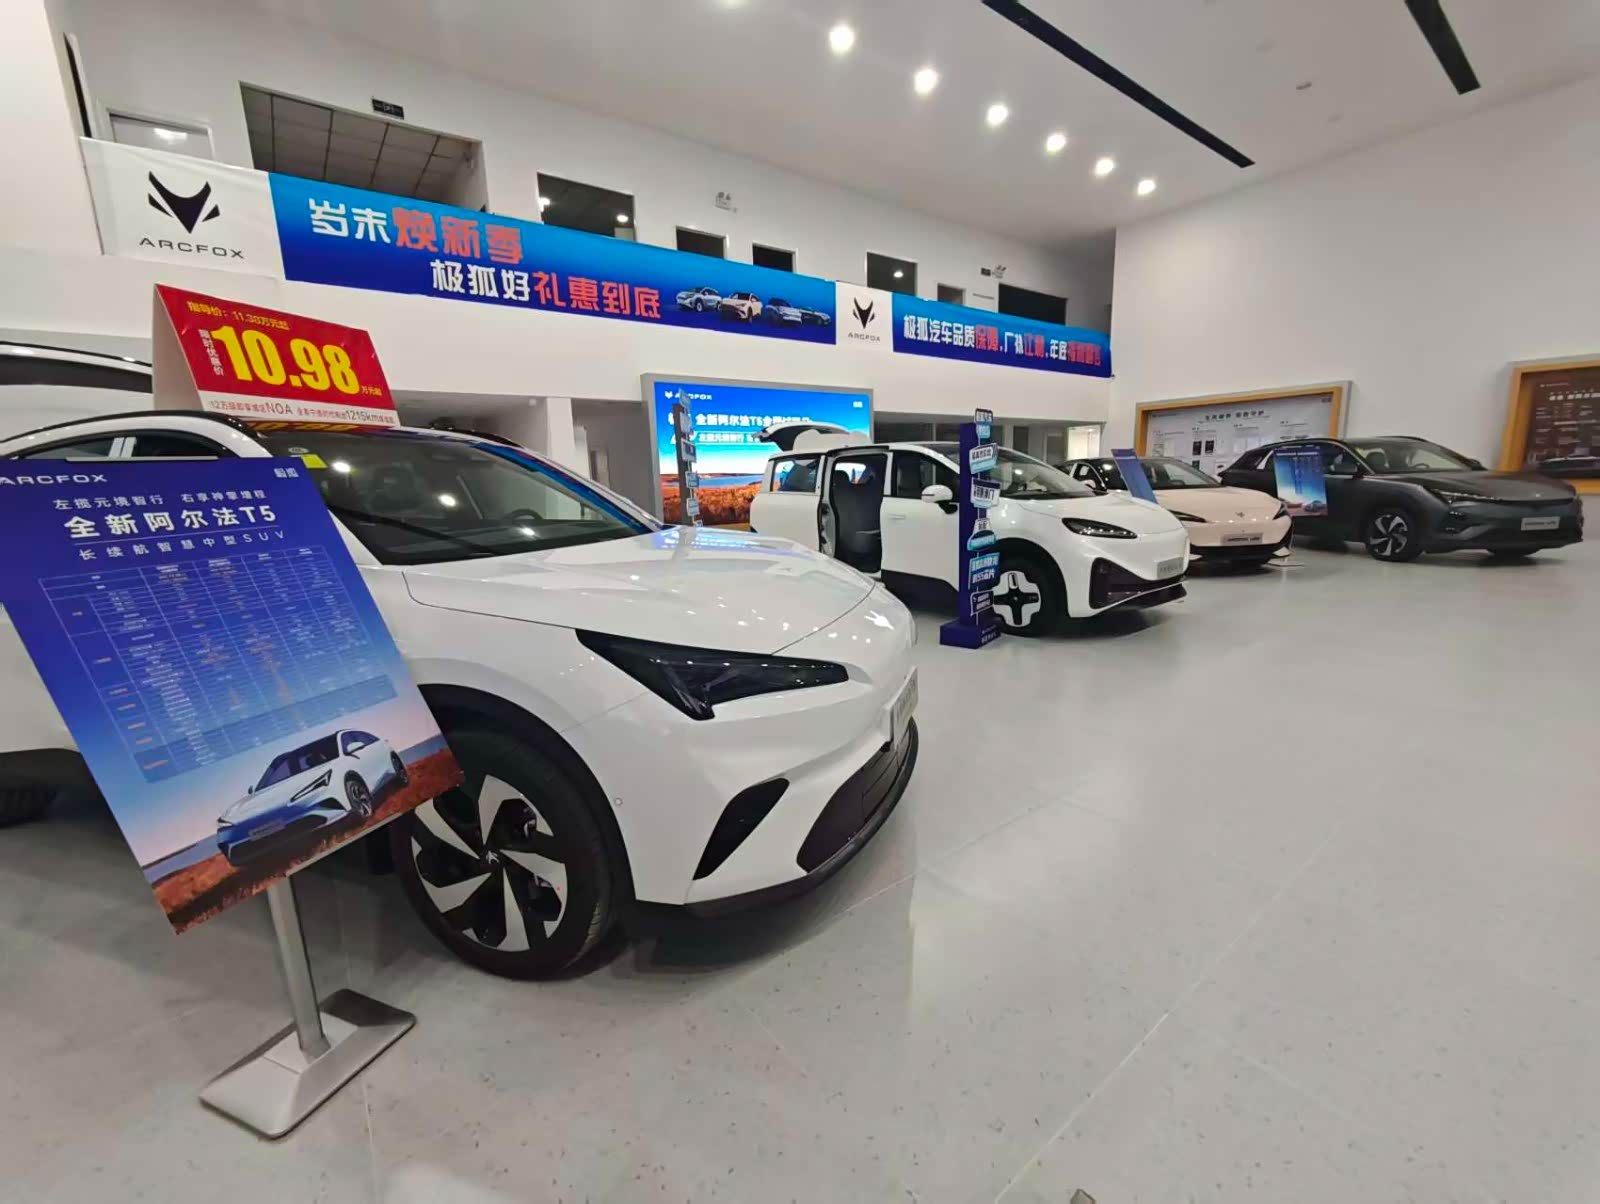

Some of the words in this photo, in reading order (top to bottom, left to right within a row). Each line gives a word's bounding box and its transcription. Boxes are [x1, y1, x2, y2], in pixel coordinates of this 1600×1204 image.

[139, 237, 245, 259] ARCFOX
[309, 198, 523, 264] 岁末焕新季
[430, 259, 661, 319] 极狐好礼惠到底
[210, 325, 360, 395] 10.98
[64, 505, 276, 538] 全新阿尔法T5
